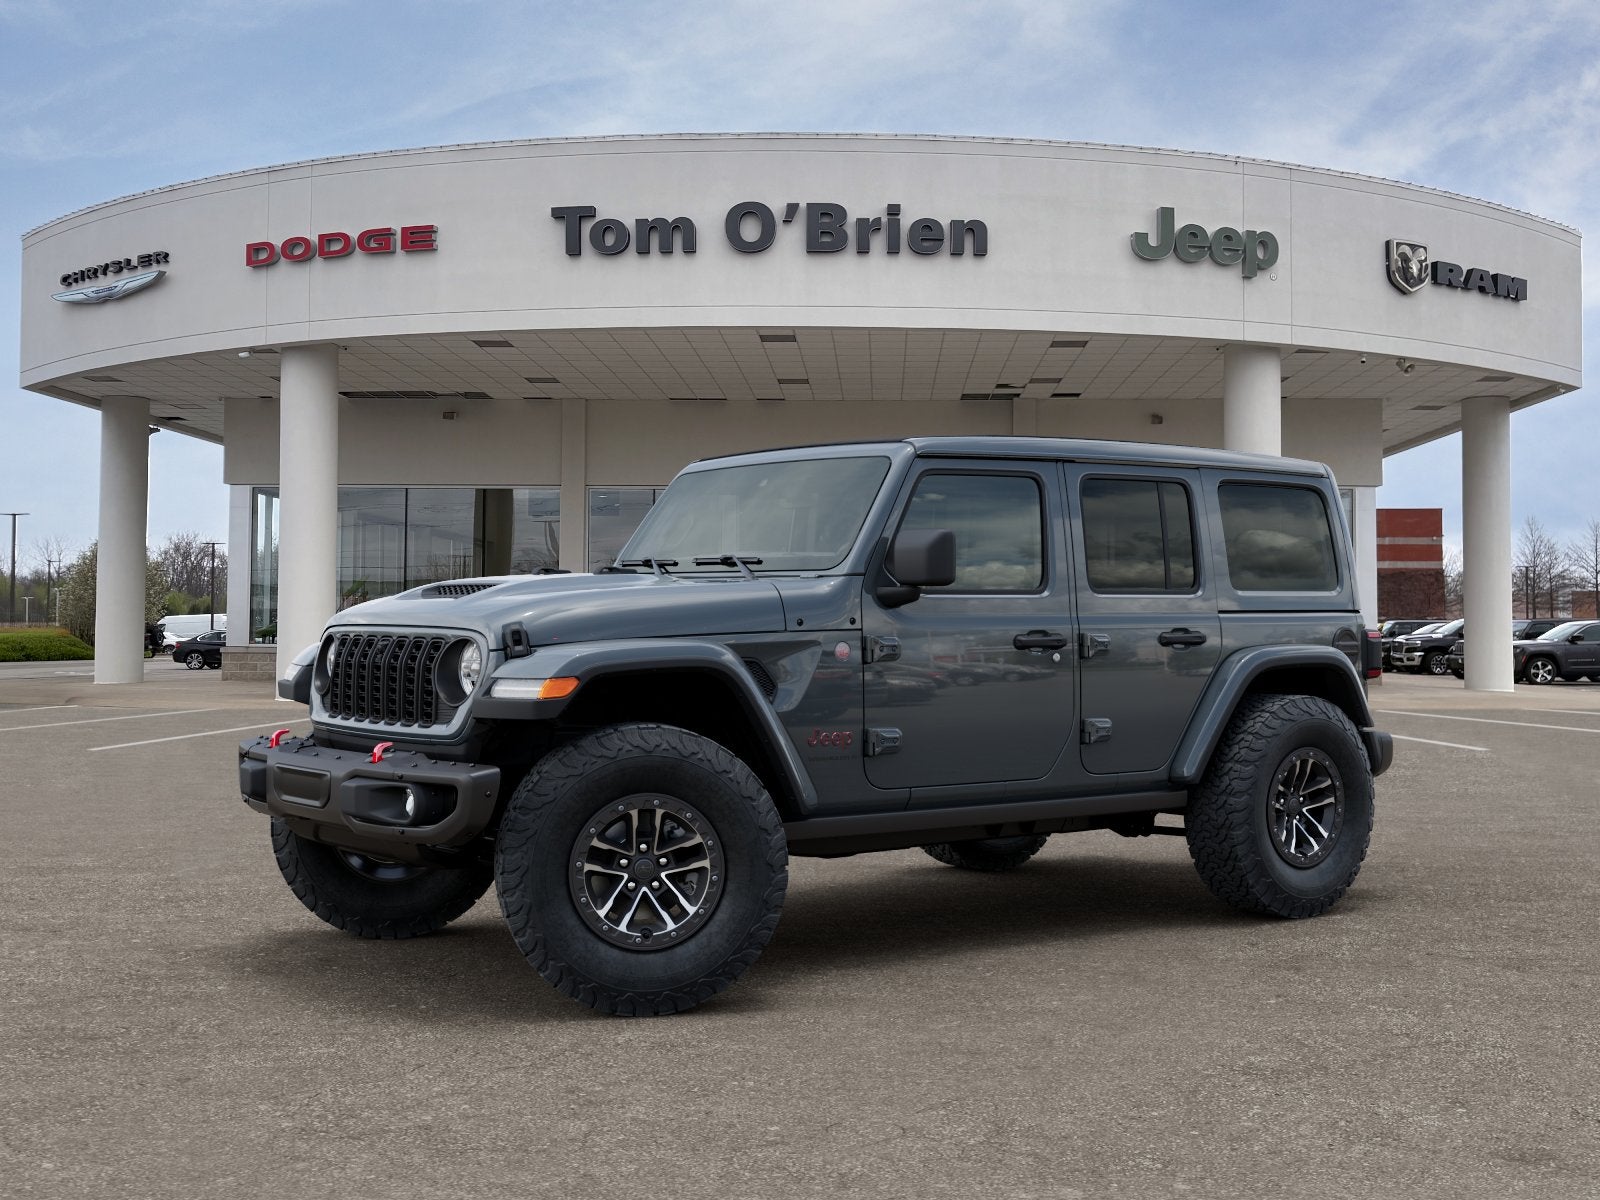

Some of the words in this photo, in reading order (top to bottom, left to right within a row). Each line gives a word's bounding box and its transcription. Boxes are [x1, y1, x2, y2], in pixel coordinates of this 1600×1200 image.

[246, 224, 438, 268] DODGE
[551, 205, 697, 256] Tom
[725, 201, 988, 256] O'Brien
[1129, 206, 1280, 279] Jeep
[60, 250, 170, 287] CHRYSLER
[1431, 260, 1528, 301] RAM
[807, 727, 853, 752] Jeep
